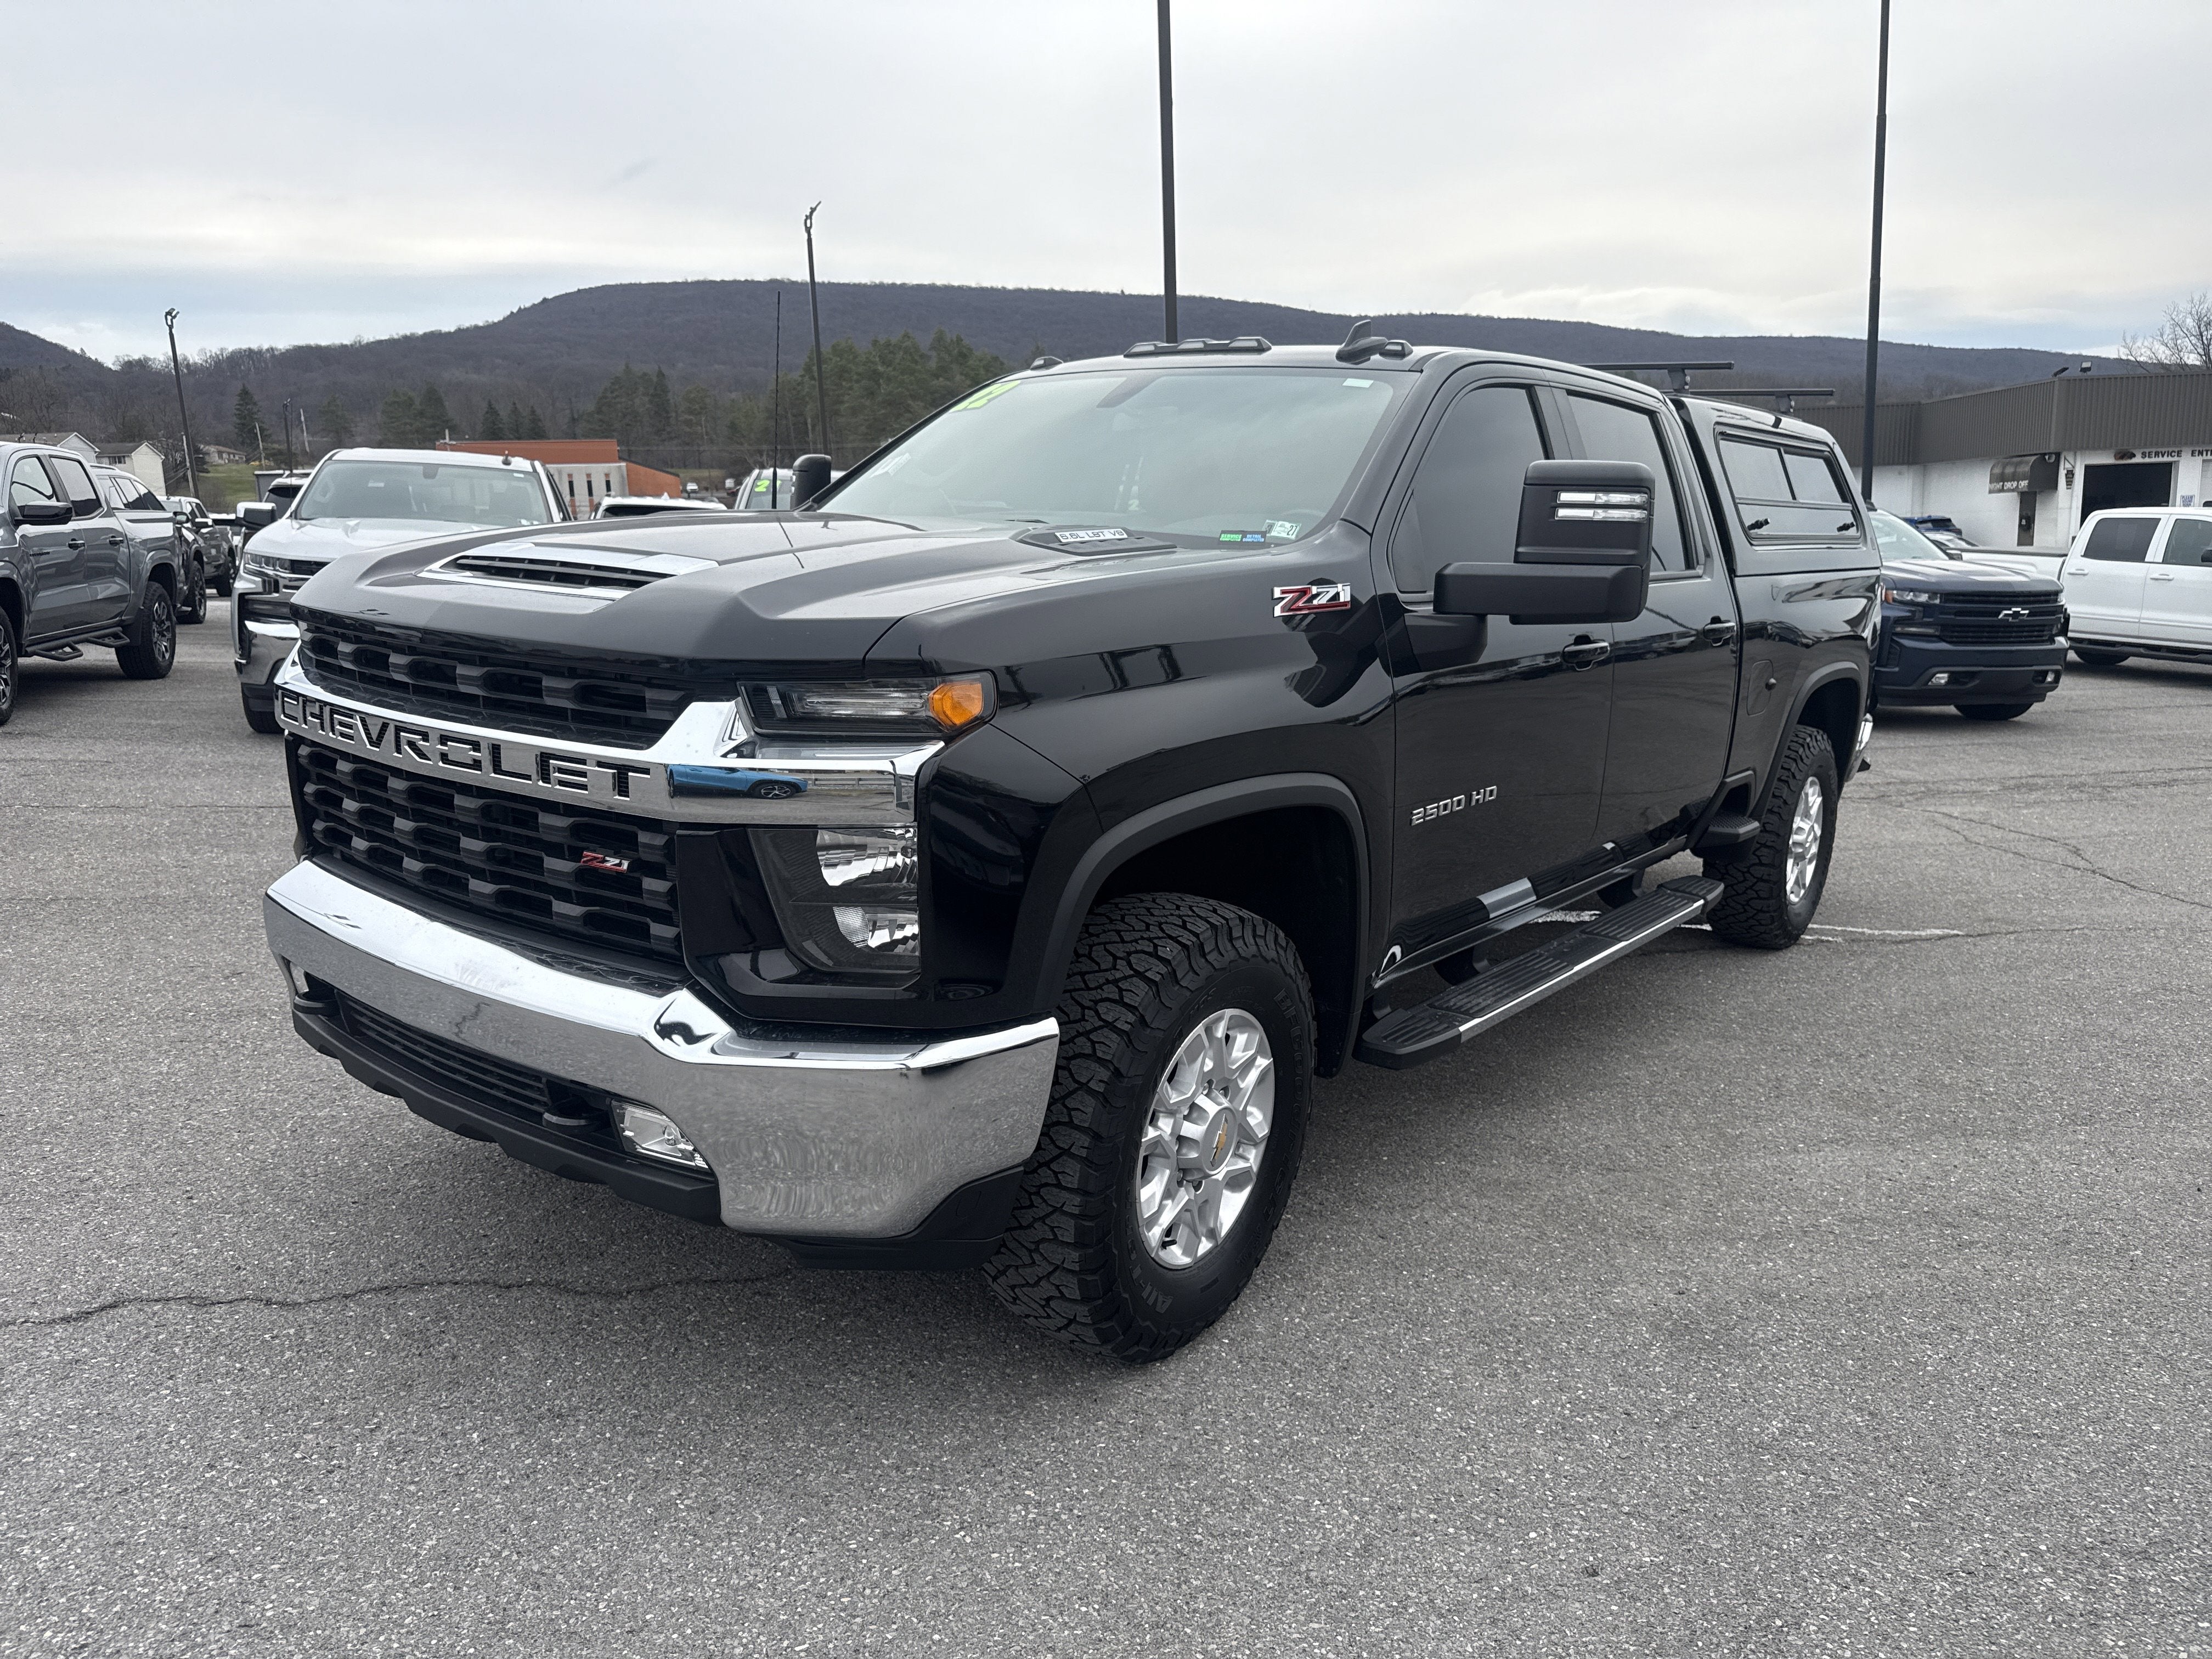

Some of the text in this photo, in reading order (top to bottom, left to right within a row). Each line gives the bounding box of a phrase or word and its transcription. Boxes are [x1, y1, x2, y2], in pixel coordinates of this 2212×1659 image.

[2141, 449, 2183, 459] SERVICE
[2004, 481, 2017, 490] DROP
[2018, 479, 2029, 489] OFF
[1286, 524, 1299, 537] 27
[1272, 583, 1351, 618] Z71
[277, 689, 651, 801] CHEVROLET
[1410, 785, 1498, 826] 2500 HD
[580, 851, 631, 873] Z71
